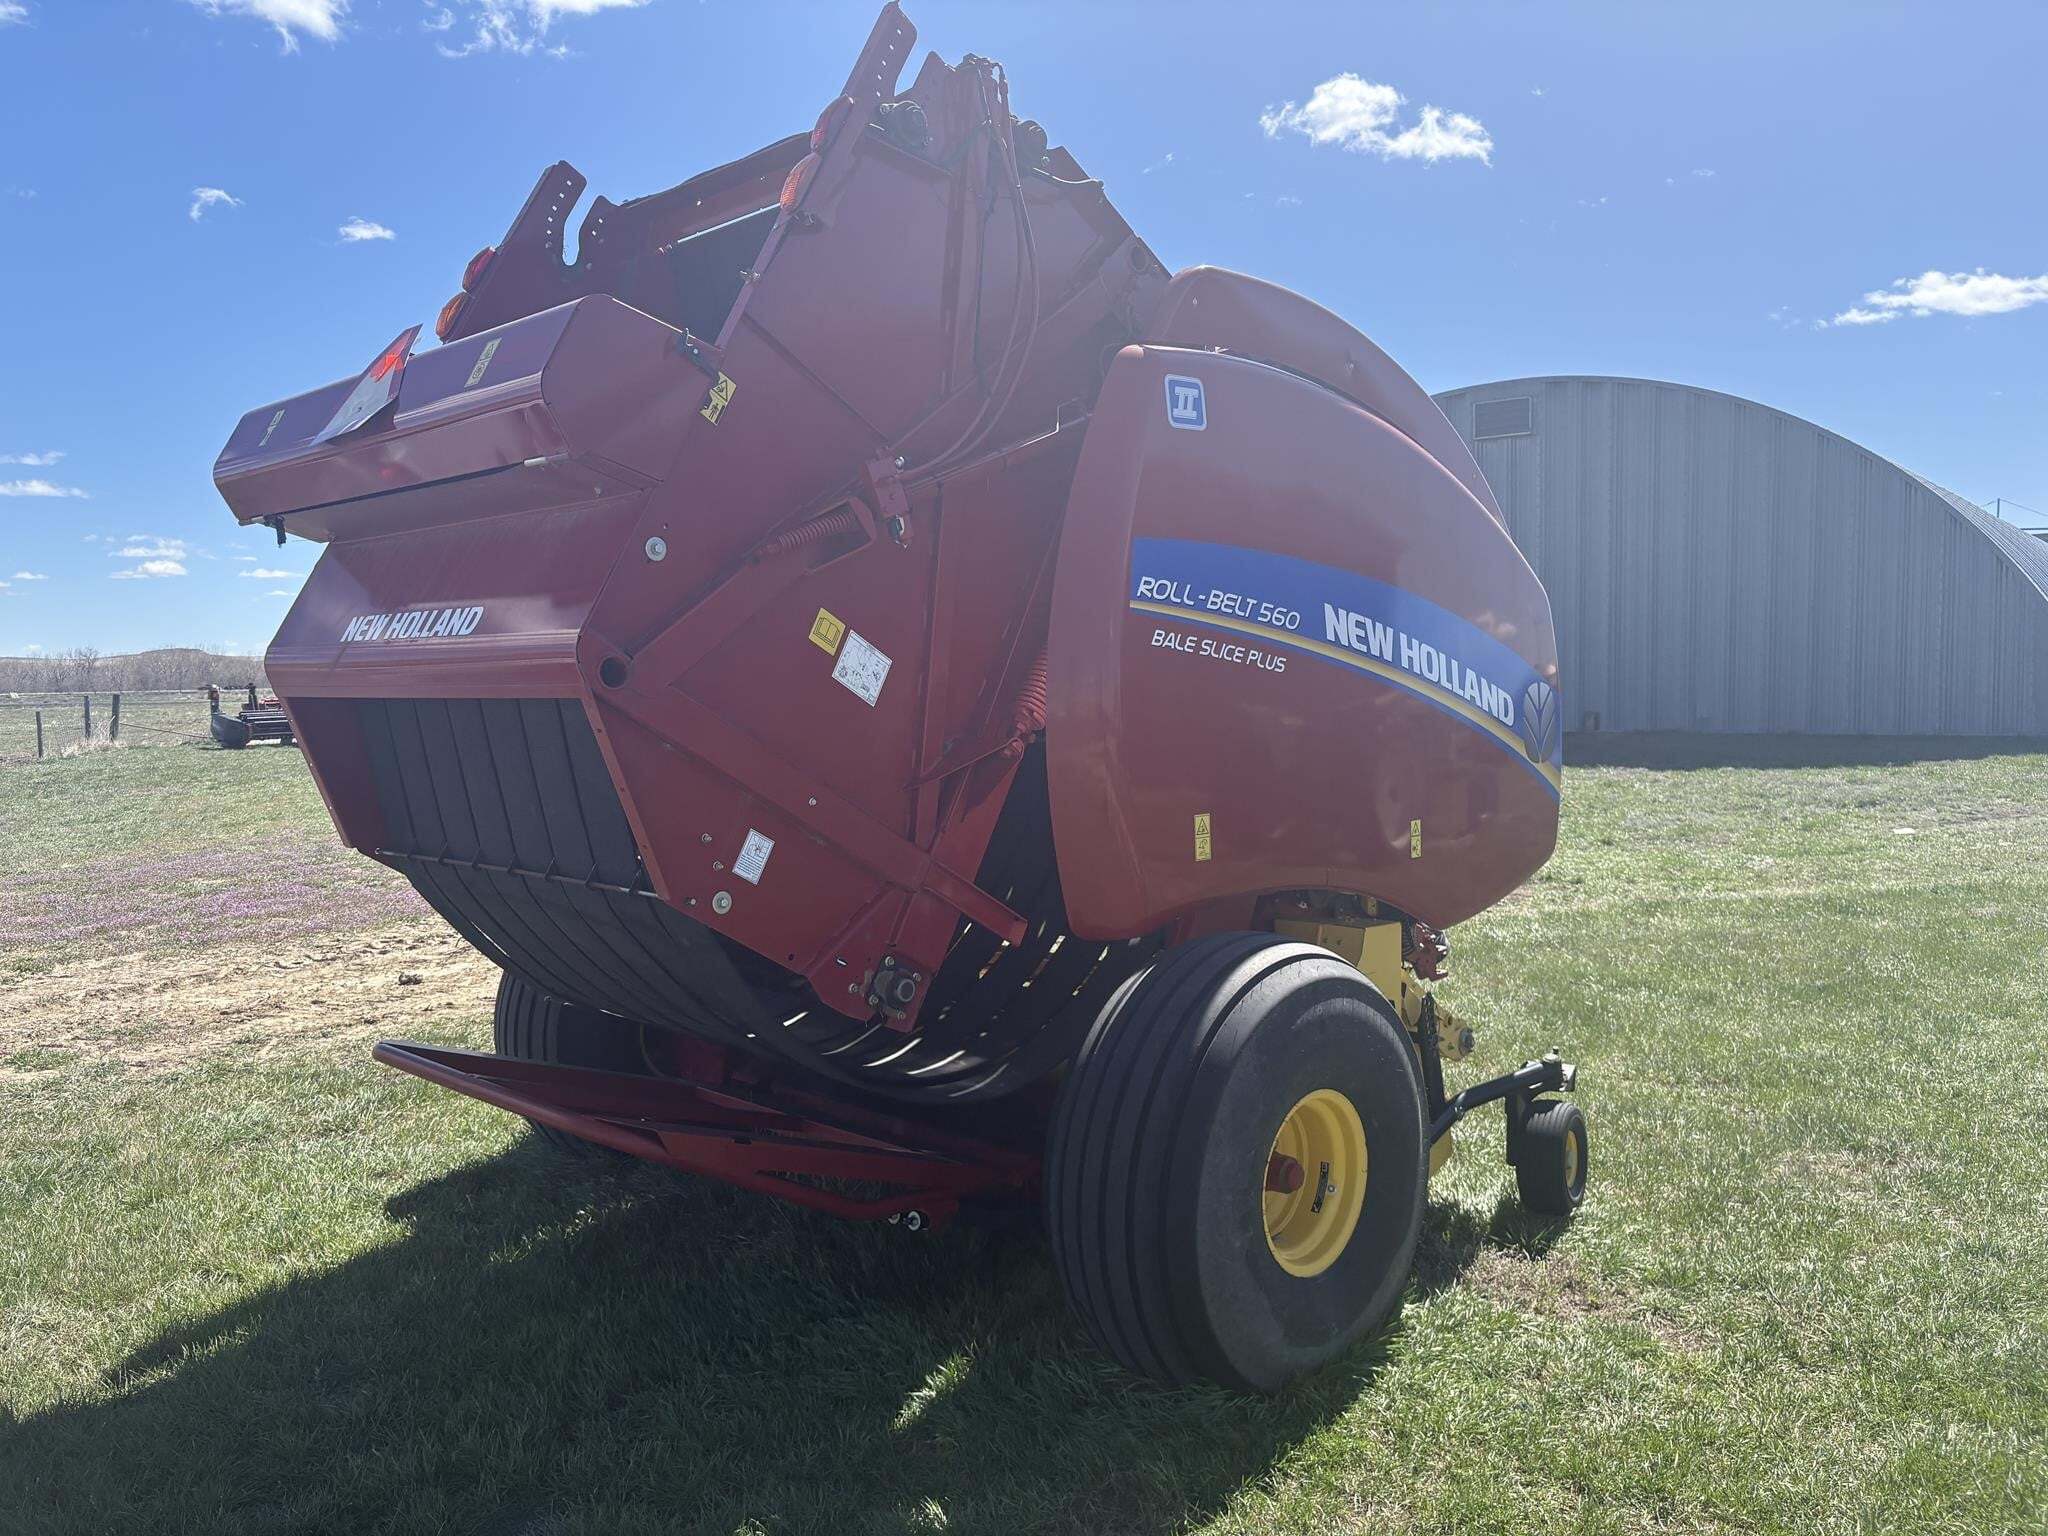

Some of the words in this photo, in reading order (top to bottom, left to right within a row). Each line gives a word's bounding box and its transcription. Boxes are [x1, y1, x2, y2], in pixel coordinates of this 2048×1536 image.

[340, 613, 392, 642] NEW
[383, 606, 484, 640] HOLLAND
[1136, 576, 1257, 618] ROLL-BELT
[1257, 602, 1301, 630] 560
[1151, 629, 1198, 653] BALE
[1199, 639, 1246, 663] SLICE
[1246, 650, 1287, 673] PLUS
[1324, 603, 1394, 662] NEW
[1399, 632, 1515, 727] HOLLAND
